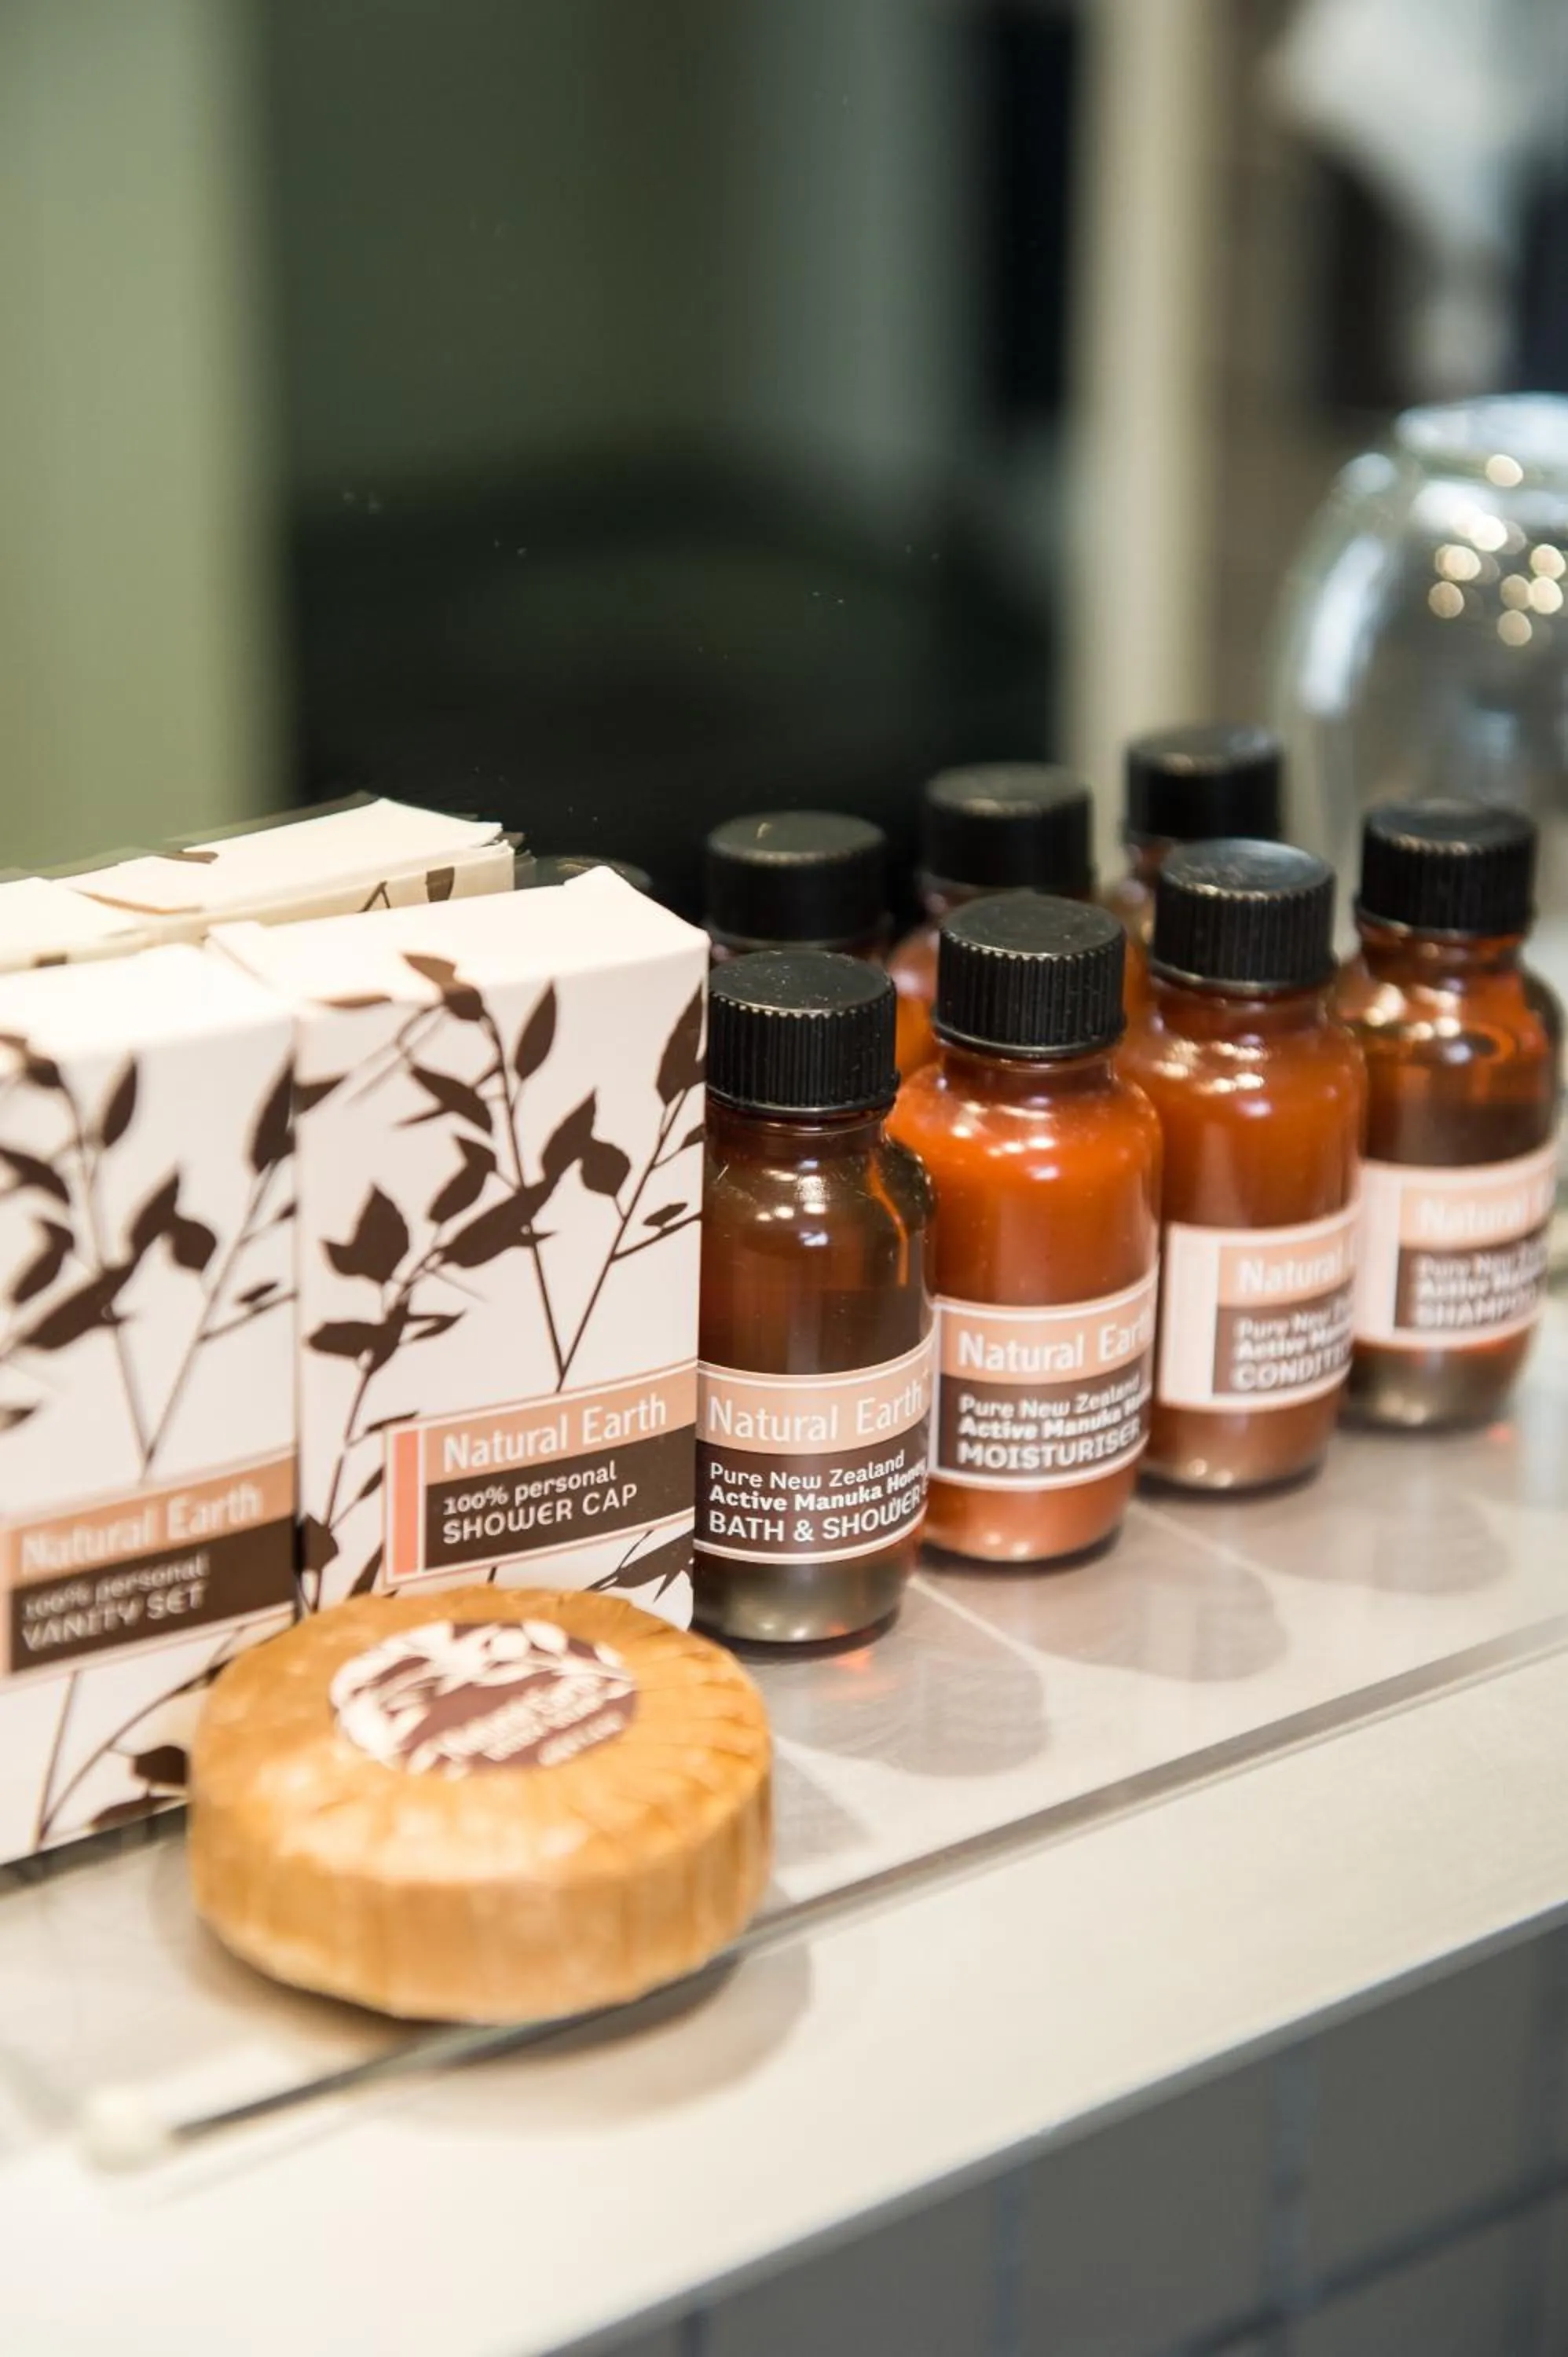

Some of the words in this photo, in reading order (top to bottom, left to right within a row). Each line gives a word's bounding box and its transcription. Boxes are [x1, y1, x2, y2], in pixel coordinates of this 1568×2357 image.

[1239, 1245, 1343, 1293] Natural
[958, 1331, 1084, 1372] Natural
[1236, 1318, 1289, 1337] Pure
[1236, 1336, 1308, 1360] Active
[709, 1395, 838, 1442] Natural
[856, 1378, 922, 1434] Earth
[958, 1394, 1014, 1417] Pure
[1020, 1397, 1070, 1419] New
[1075, 1373, 1140, 1413] Zealand
[443, 1415, 568, 1474] Natural
[582, 1393, 666, 1446] Earth
[958, 1416, 1037, 1440] Active
[1042, 1407, 1121, 1439] Manuka
[958, 1417, 1140, 1469] MOISTURISER
[443, 1484, 509, 1516] 100%
[515, 1460, 617, 1507] personal
[709, 1462, 763, 1487] Pure
[770, 1472, 821, 1490] New
[829, 1450, 905, 1488] Zealand
[442, 1500, 572, 1545] SHOWER
[582, 1483, 637, 1516] CAP
[709, 1485, 787, 1511] Active
[794, 1484, 883, 1511] Manuka
[709, 1510, 785, 1541] BATH
[793, 1519, 814, 1541] &
[823, 1489, 921, 1540] SHOWER
[21, 1501, 156, 1575] Natural
[167, 1481, 262, 1541] Earth
[94, 1550, 211, 1609] personal
[21, 1595, 145, 1651] VANITY
[146, 1578, 210, 1620] SET
